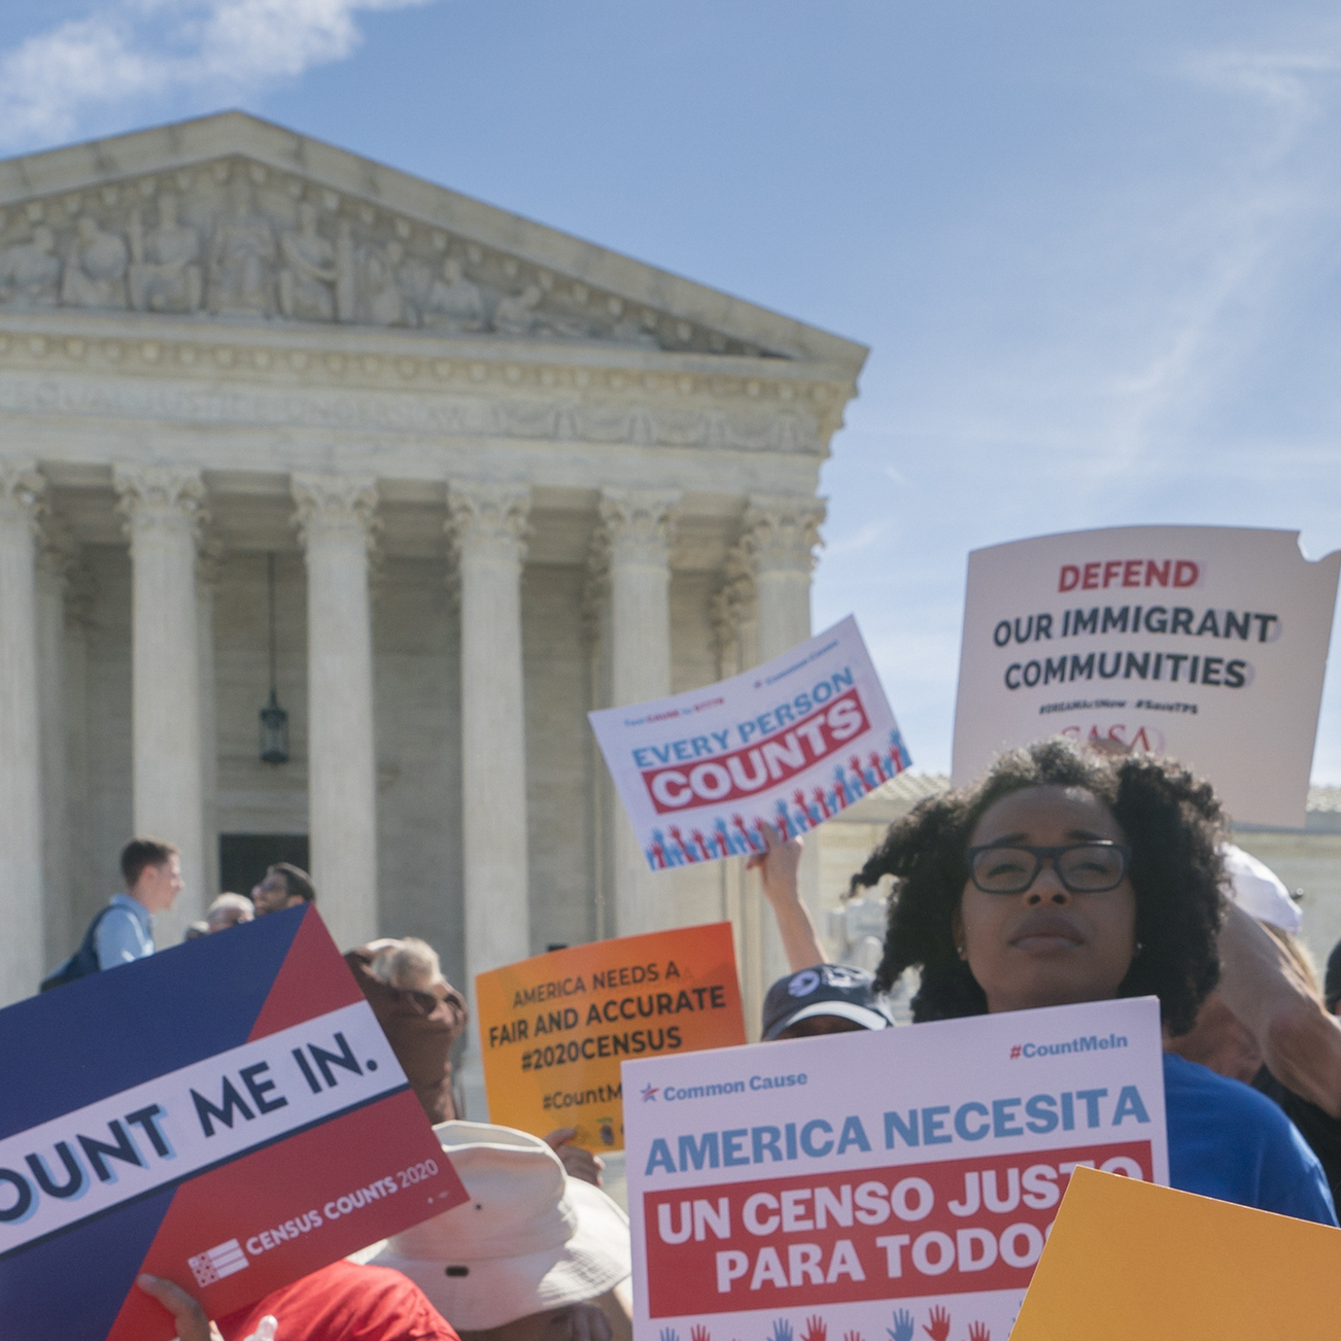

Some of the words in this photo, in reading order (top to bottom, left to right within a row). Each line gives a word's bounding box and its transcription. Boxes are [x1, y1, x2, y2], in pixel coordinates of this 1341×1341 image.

[1058, 560, 1200, 593] DEFEND
[994, 613, 1053, 647] OUR
[1062, 605, 1278, 643] IMMIGRANT
[1004, 651, 1247, 690] COMMUNITIES
[631, 728, 730, 768] EVERY
[738, 666, 855, 744] PERSON
[651, 697, 864, 807] COUNTS
[513, 976, 587, 1009] AMERICA
[592, 962, 659, 991] NEEDS
[664, 960, 681, 980] A
[488, 1019, 529, 1048] FAIR
[534, 1007, 579, 1037] AND
[586, 985, 726, 1026] ACCURATE
[521, 1026, 682, 1072] #2020CENSUS
[1009, 1032, 1129, 1061] #CountMeIn
[189, 1061, 289, 1139] ME
[291, 1031, 379, 1095] IN.
[542, 1082, 622, 1111] #CountM
[663, 1078, 746, 1102] Common
[749, 1070, 808, 1092] Cause
[643, 1115, 873, 1177] AMERICA
[883, 1084, 1152, 1151] NECESITA
[246, 1209, 323, 1256] CENSUS
[323, 1175, 399, 1220] COUNTS
[396, 1158, 439, 1189] 2020
[658, 1197, 732, 1246] UN
[742, 1176, 935, 1237] CENSO
[715, 1238, 867, 1294] PARA
[876, 1222, 1051, 1280] TODO
